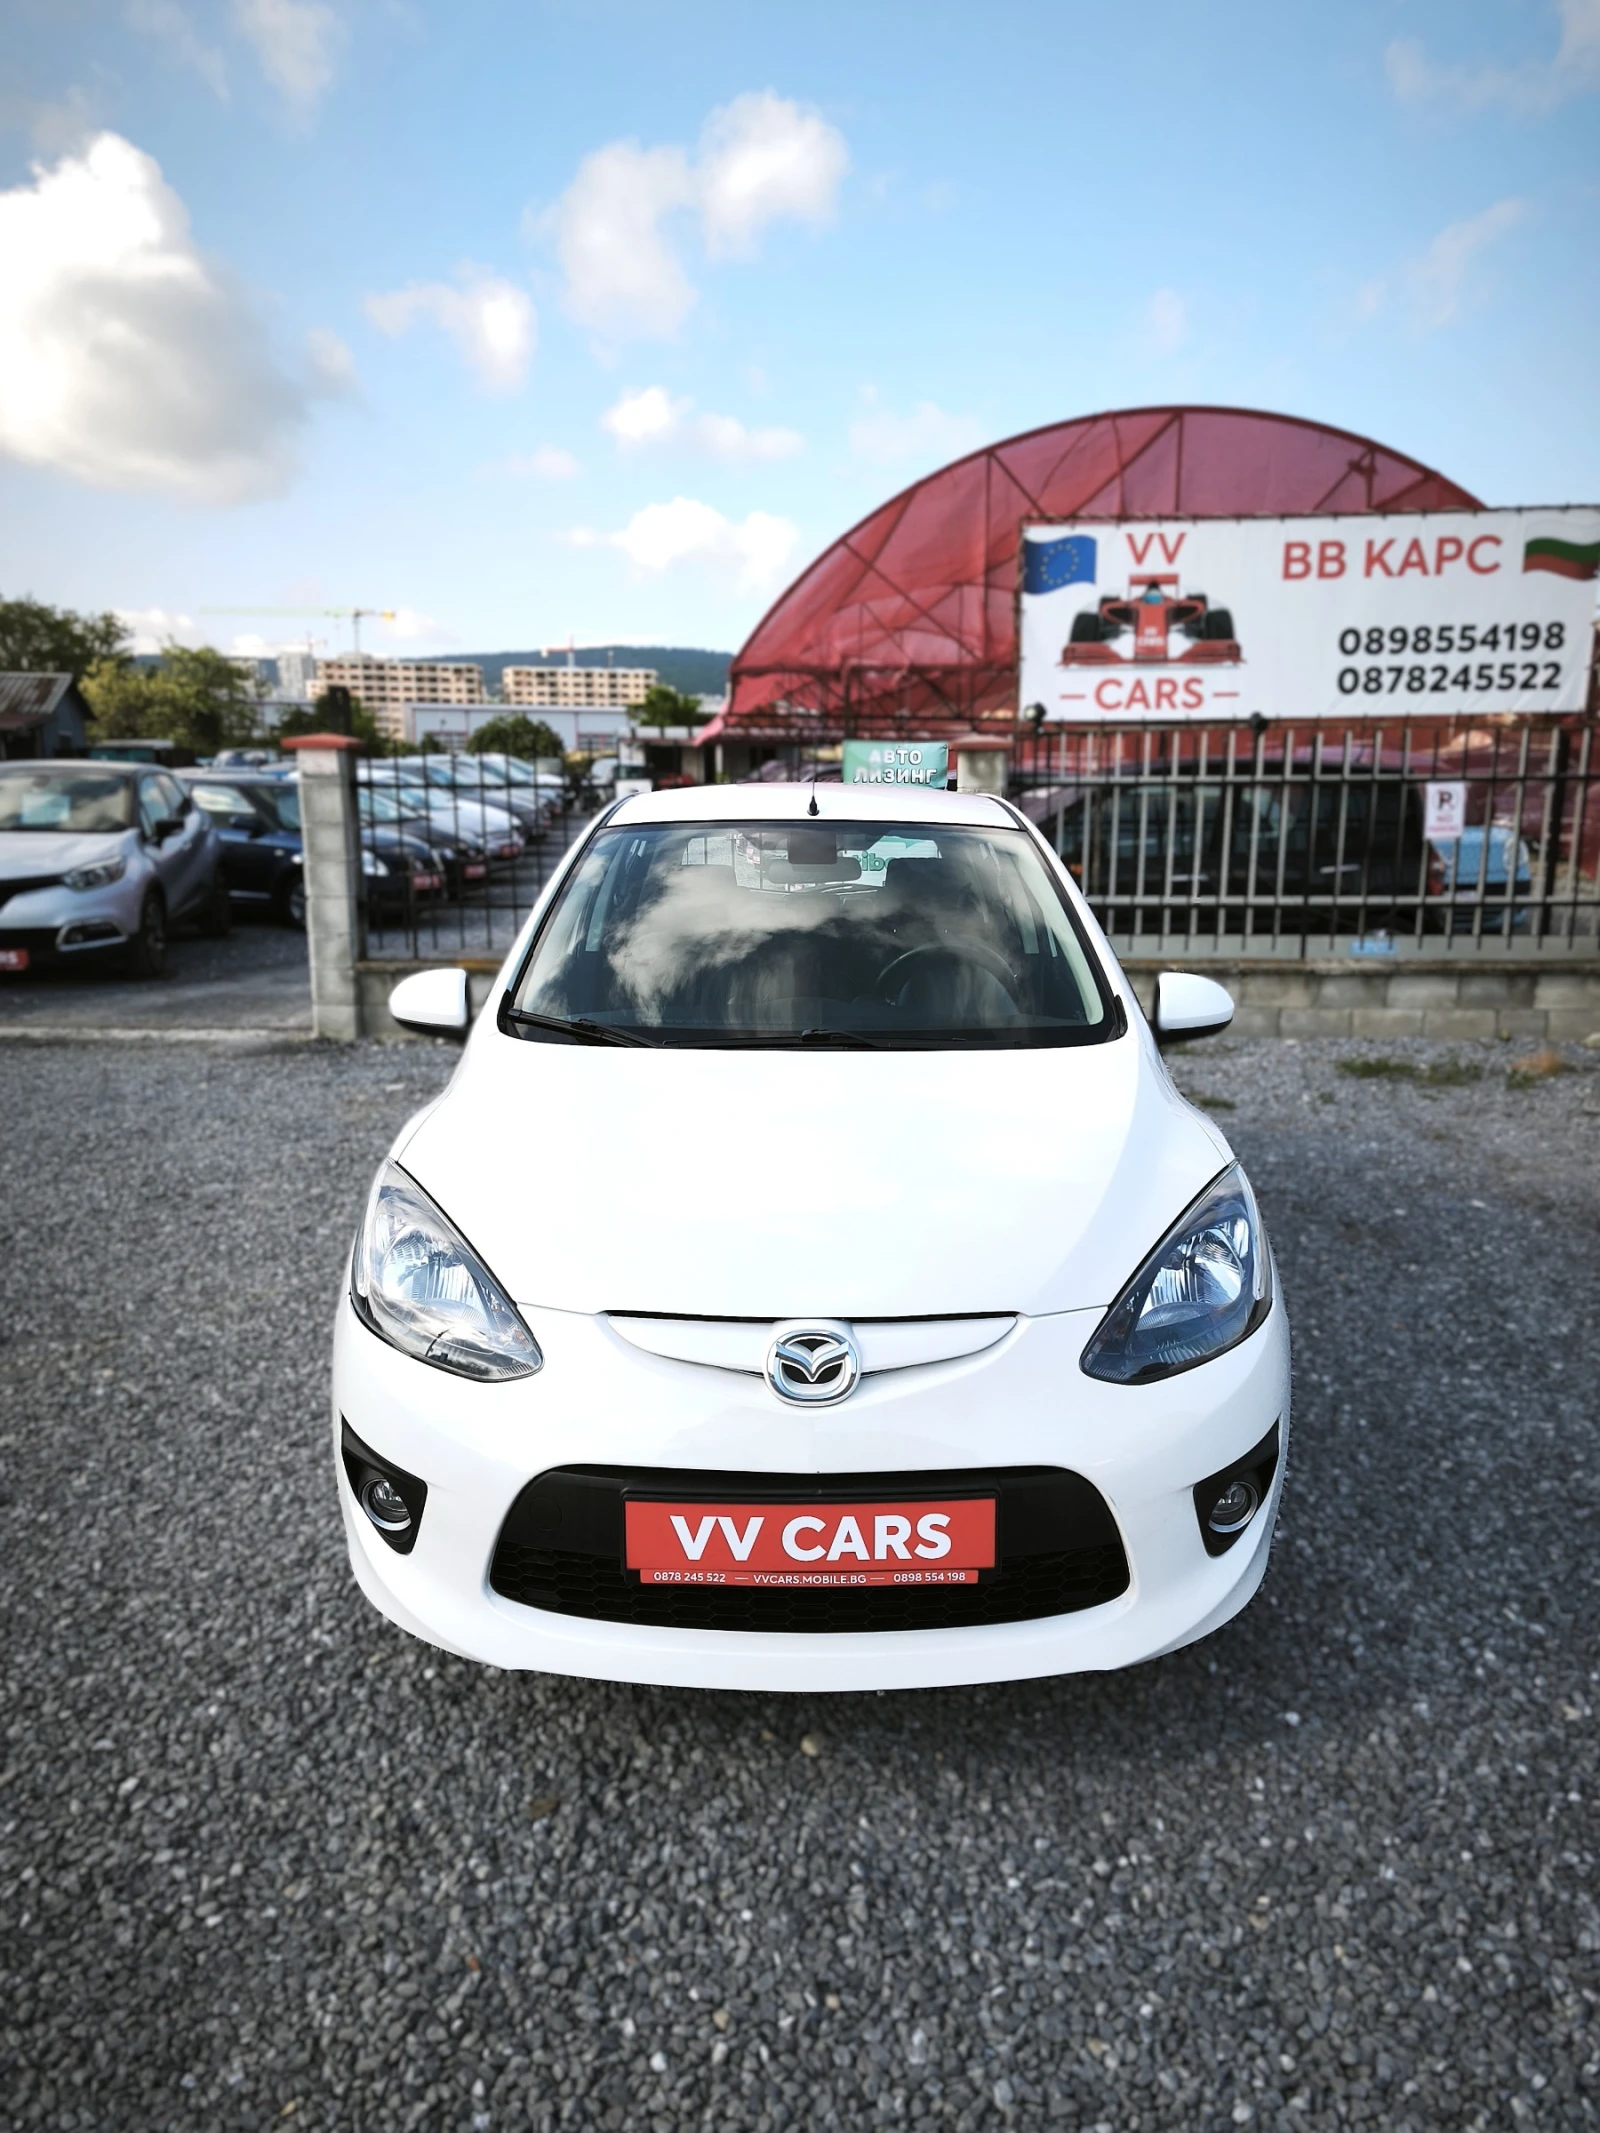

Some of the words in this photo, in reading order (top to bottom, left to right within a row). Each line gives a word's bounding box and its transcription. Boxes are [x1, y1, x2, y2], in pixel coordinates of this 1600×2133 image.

[1126, 532, 1186, 565] VV
[1282, 540, 1346, 580] ВВ
[1364, 535, 1503, 577] КАРС
[1338, 622, 1566, 656] 0898554198
[1094, 677, 1205, 711] CARS
[1337, 662, 1562, 695] 0878245522
[868, 749, 922, 765] АВТО
[853, 767, 937, 784] ЛИЗИНГ
[669, 1515, 765, 1561] VV
[781, 1513, 953, 1562] CARS
[653, 1571, 682, 1582] 0878
[684, 1572, 704, 1582] 245
[706, 1573, 727, 1583] 522
[753, 1574, 867, 1585] VVCARS.MOBILE.BG
[893, 1573, 922, 1583] 0898
[924, 1572, 945, 1582] 554
[946, 1571, 967, 1582] 198
